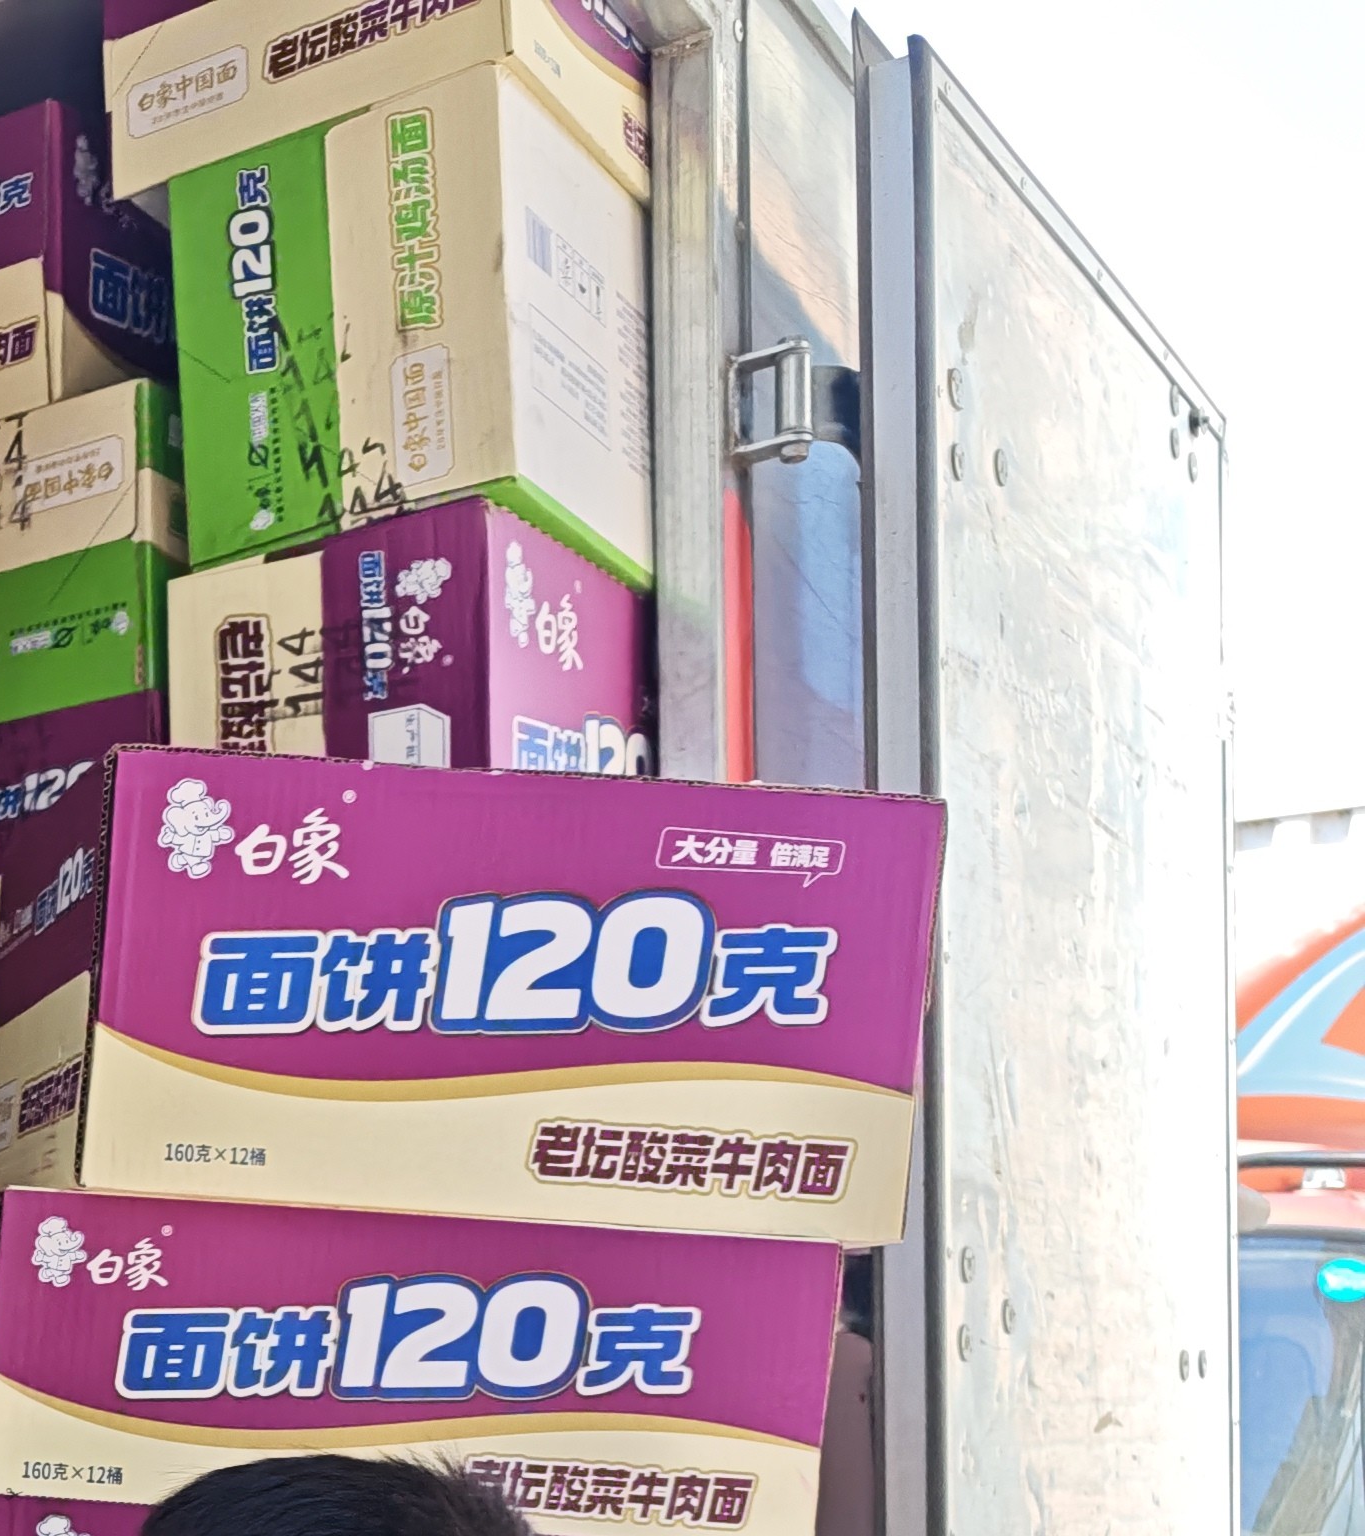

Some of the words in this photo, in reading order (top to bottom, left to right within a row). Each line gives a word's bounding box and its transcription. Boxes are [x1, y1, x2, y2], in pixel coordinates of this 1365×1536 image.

[263, 0, 486, 84] 老坛酸菜牛肉
[137, 59, 238, 113] 白象中国面
[385, 108, 442, 332] 原汁鸡汤面
[230, 165, 279, 374] 面饼120克
[401, 362, 427, 473] 白象中国面
[357, 550, 395, 703] 面饼120克
[399, 604, 445, 676] 白象
[535, 593, 584, 673] 白象
[235, 808, 350, 885] 白象
[672, 834, 758, 867] 大分量
[770, 842, 830, 868] 倍满足
[195, 887, 839, 1037] 面饼120克
[164, 1143, 267, 1167] 160克×12桶
[526, 1116, 859, 1204] 老坛酸菜牛肉面
[87, 1237, 170, 1292] 白象
[115, 1272, 701, 1401] 面饼120克
[22, 1460, 124, 1486] 160克×12桶
